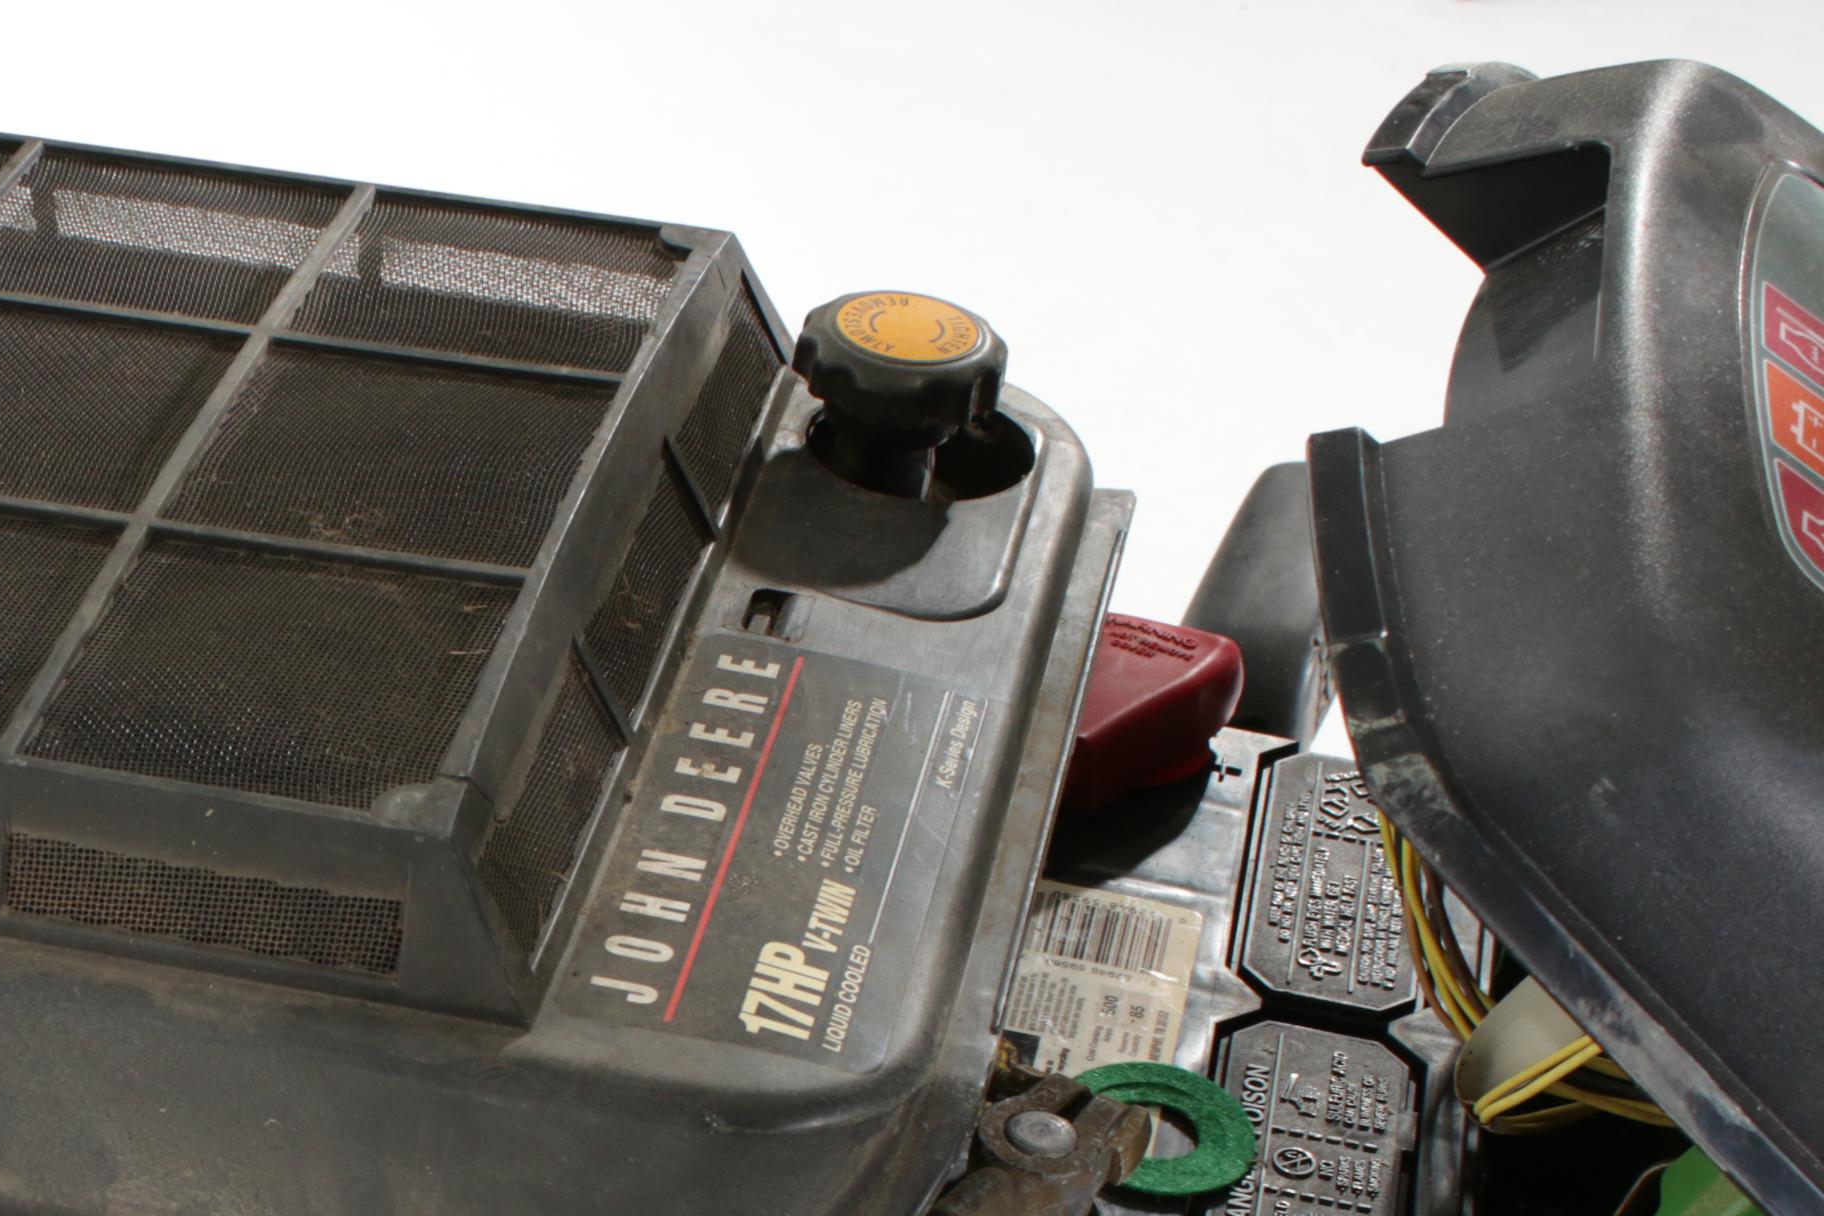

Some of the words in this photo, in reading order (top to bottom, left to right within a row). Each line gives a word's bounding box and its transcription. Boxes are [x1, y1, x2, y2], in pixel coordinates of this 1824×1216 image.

[837, 699, 863, 741] LINERS
[935, 740, 964, 789] K-Series
[950, 700, 978, 740] Design
[818, 738, 849, 794] CYLINDER
[821, 768, 864, 861] FULL-PRESSURE
[851, 696, 887, 770] LUBRICATION
[773, 786, 807, 851] OVERHEAD
[795, 743, 823, 786] VALVES
[809, 793, 828, 823] IRON
[590, 849, 707, 1004] JOHN
[660, 654, 781, 822] DEERE
[797, 822, 821, 855] CAST
[851, 804, 878, 845] FILTER
[844, 843, 865, 867] OIL
[738, 941, 830, 1040] 17HP
[801, 878, 857, 953] V-TWIN
[821, 1003, 853, 1053] LIQUID
[838, 944, 871, 1004] COOLED
[1103, 995, 1119, 1015] 500
[1332, 1051, 1348, 1075] ACID
[1319, 1159, 1334, 1178] NO
